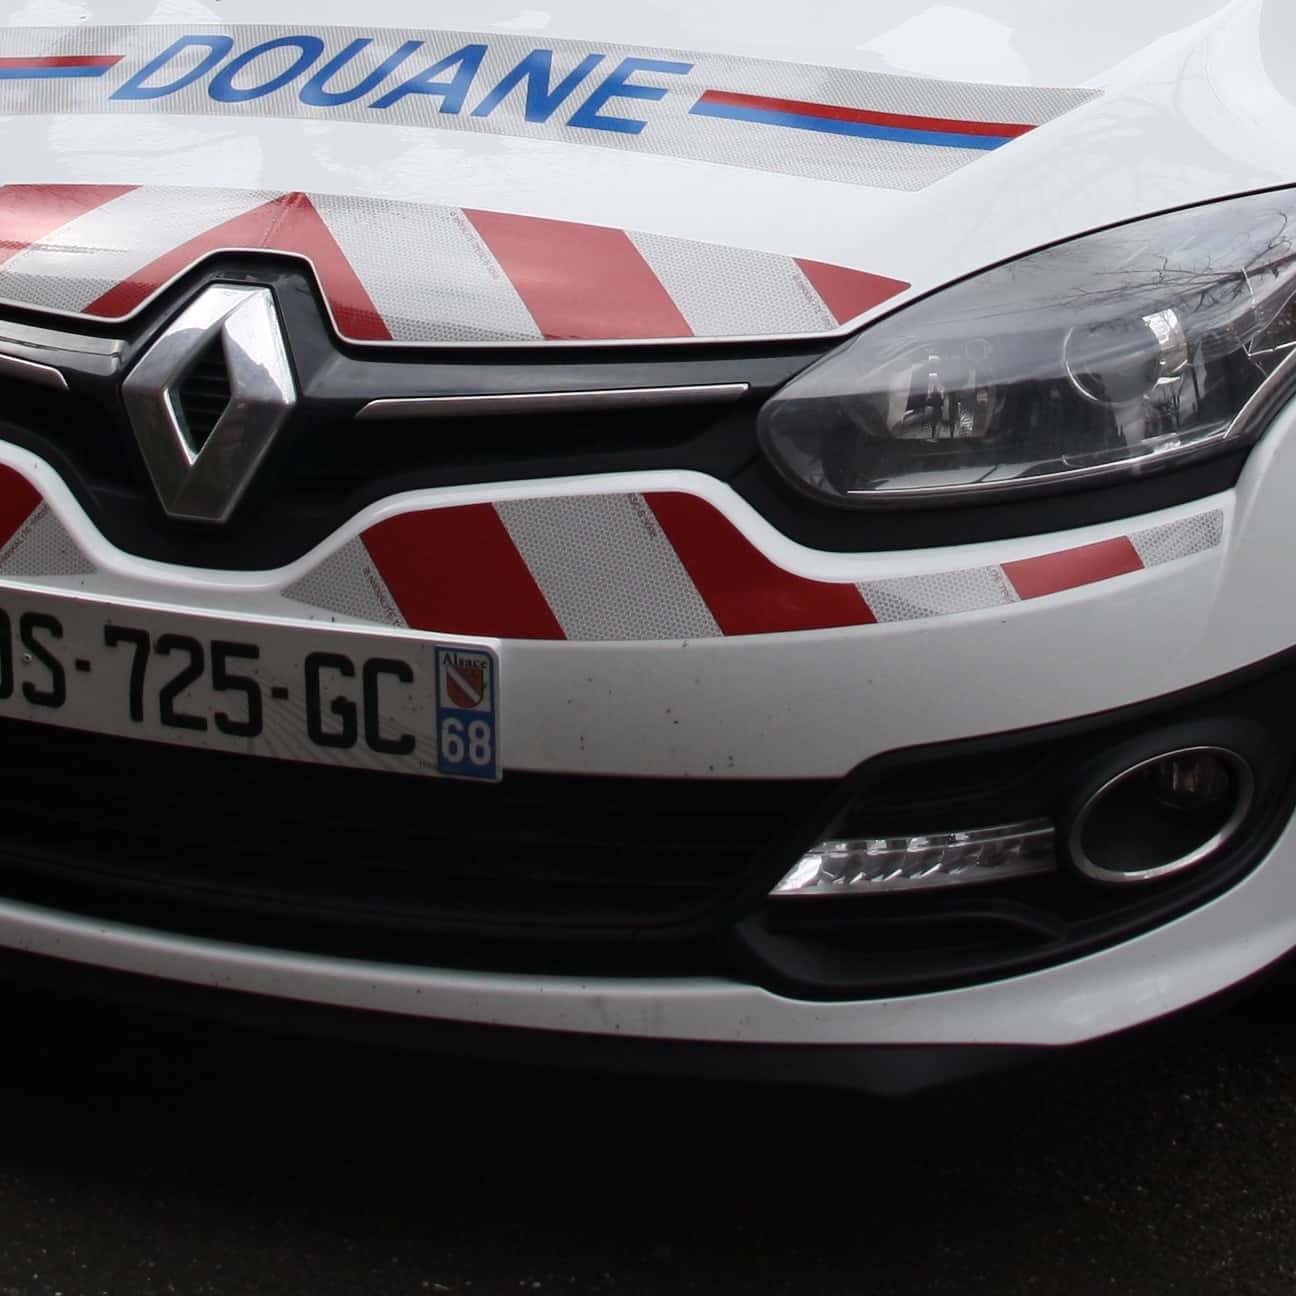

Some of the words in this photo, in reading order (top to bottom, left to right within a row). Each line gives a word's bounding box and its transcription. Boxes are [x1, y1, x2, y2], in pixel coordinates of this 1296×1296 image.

[107, 34, 694, 136] DOUANE
[442, 653, 489, 670] Alsace
[441, 716, 492, 766] 68
